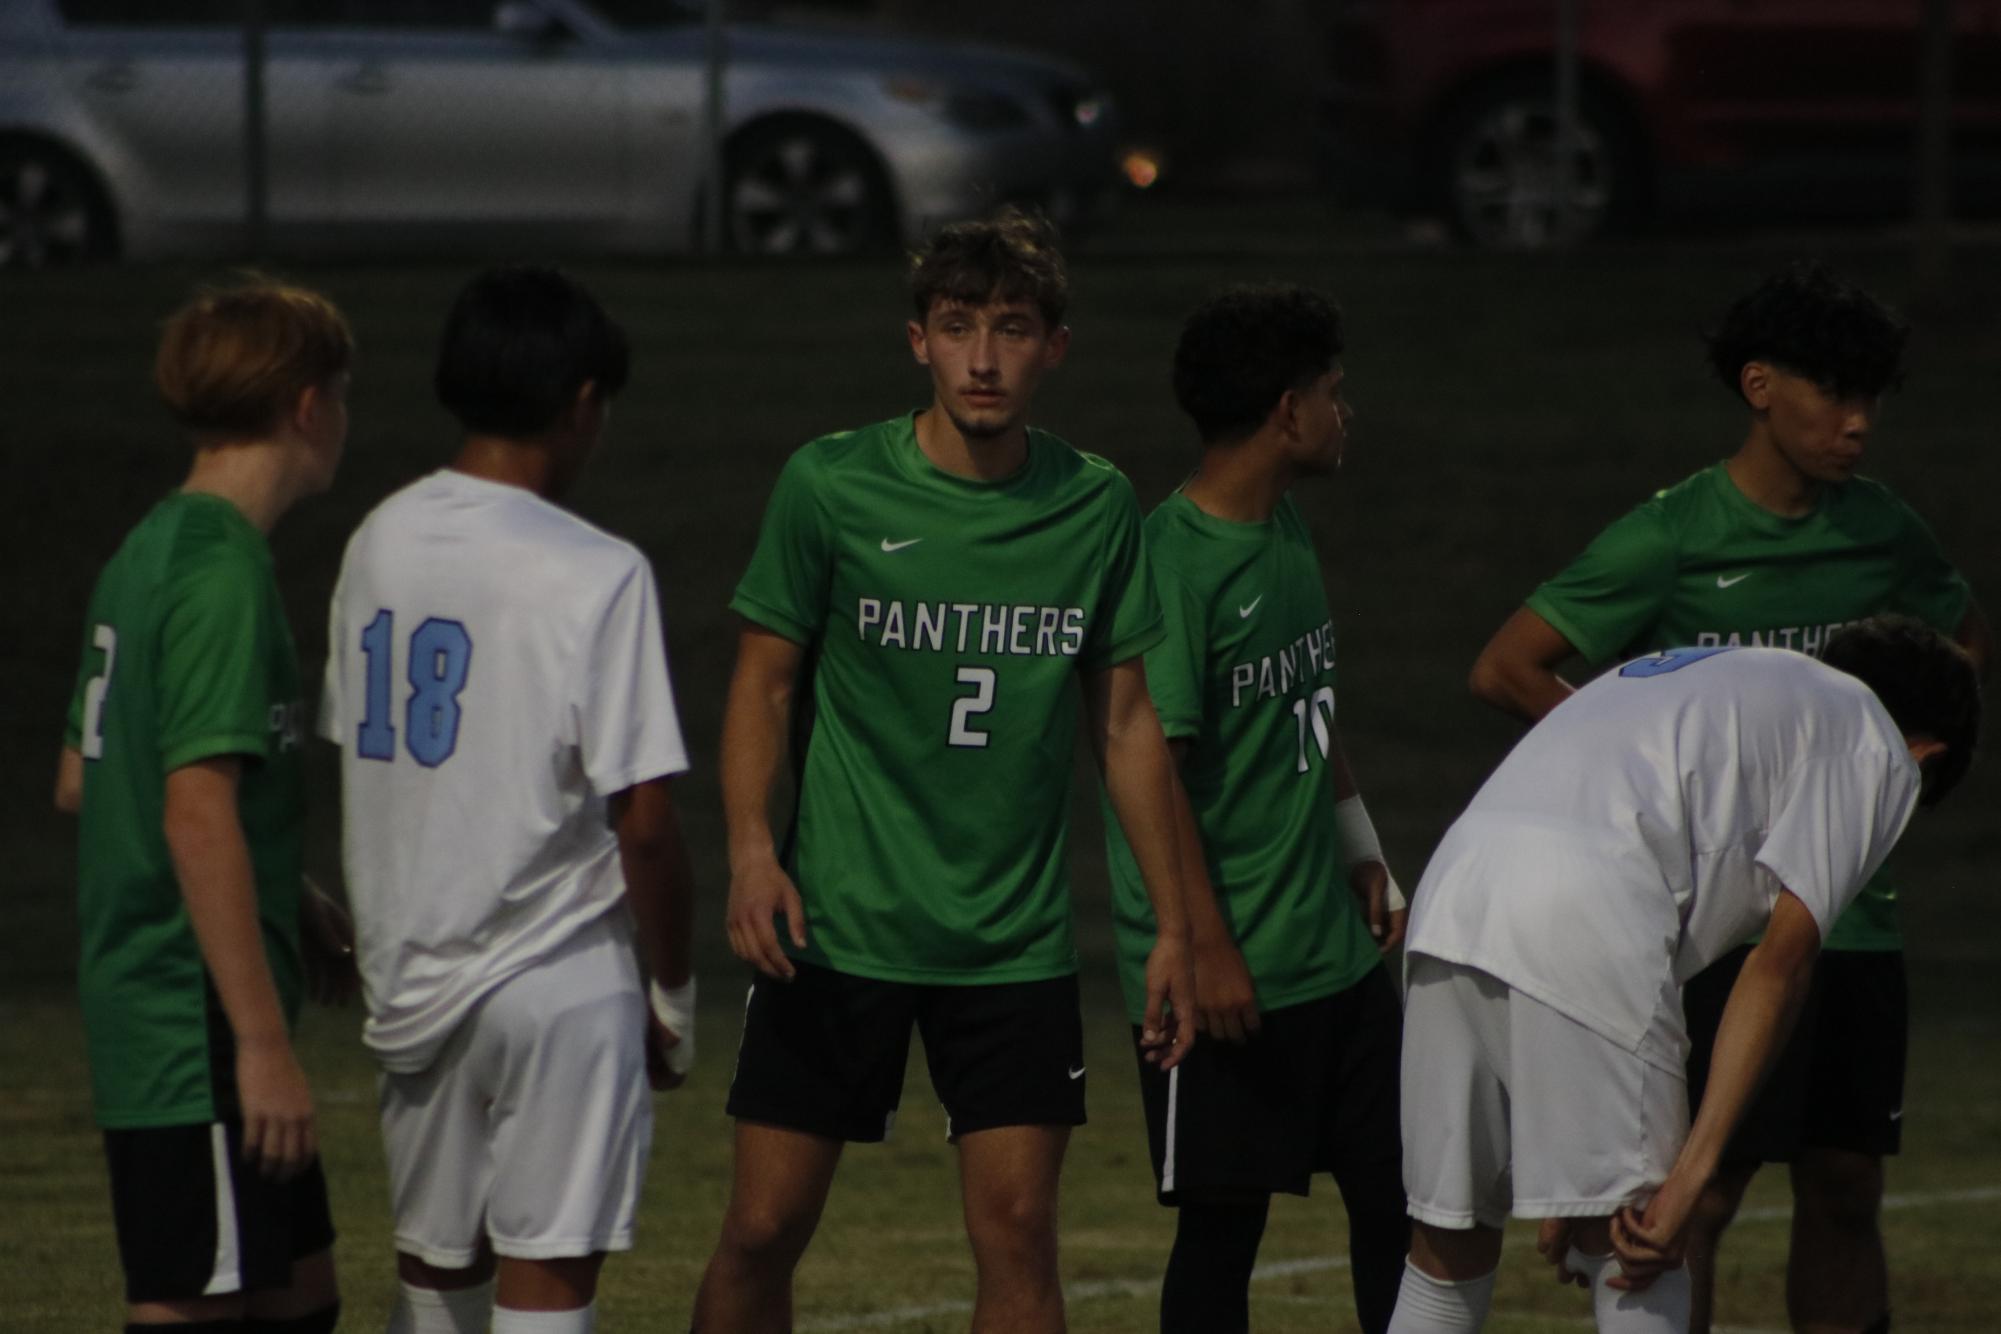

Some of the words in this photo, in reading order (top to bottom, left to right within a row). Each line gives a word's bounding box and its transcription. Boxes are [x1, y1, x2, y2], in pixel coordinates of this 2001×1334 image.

[858, 597, 1085, 656] PANTHERS
[1232, 618, 1336, 707] PANTHE
[81, 623, 117, 762] 2
[357, 608, 473, 769] 18
[947, 666, 996, 748] 2
